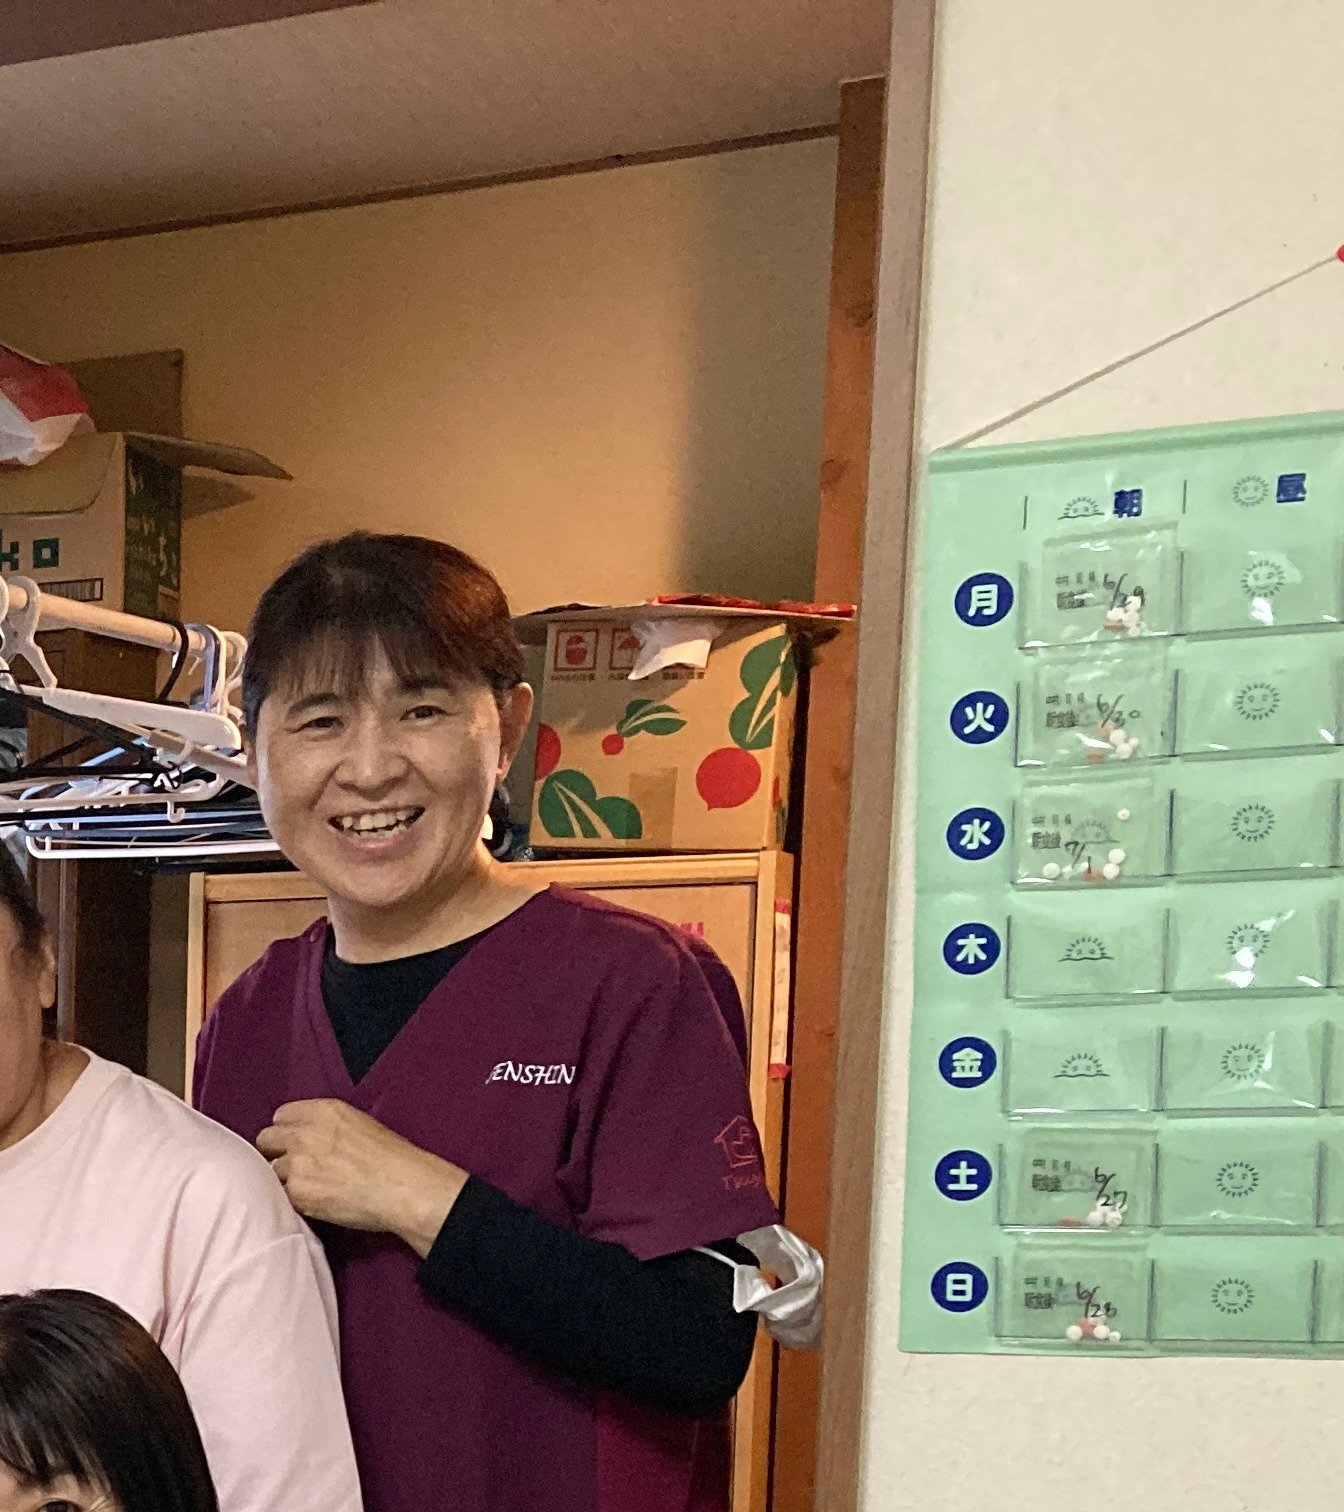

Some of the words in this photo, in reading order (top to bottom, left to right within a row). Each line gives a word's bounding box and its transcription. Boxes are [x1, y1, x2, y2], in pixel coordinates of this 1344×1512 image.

[968, 583, 999, 617] 月
[963, 702, 995, 735] 火
[959, 818, 992, 850] 水
[955, 933, 987, 964] 木
[951, 1047, 984, 1078] 金
[947, 1161, 979, 1191] 土
[945, 1273, 974, 1302] 日
